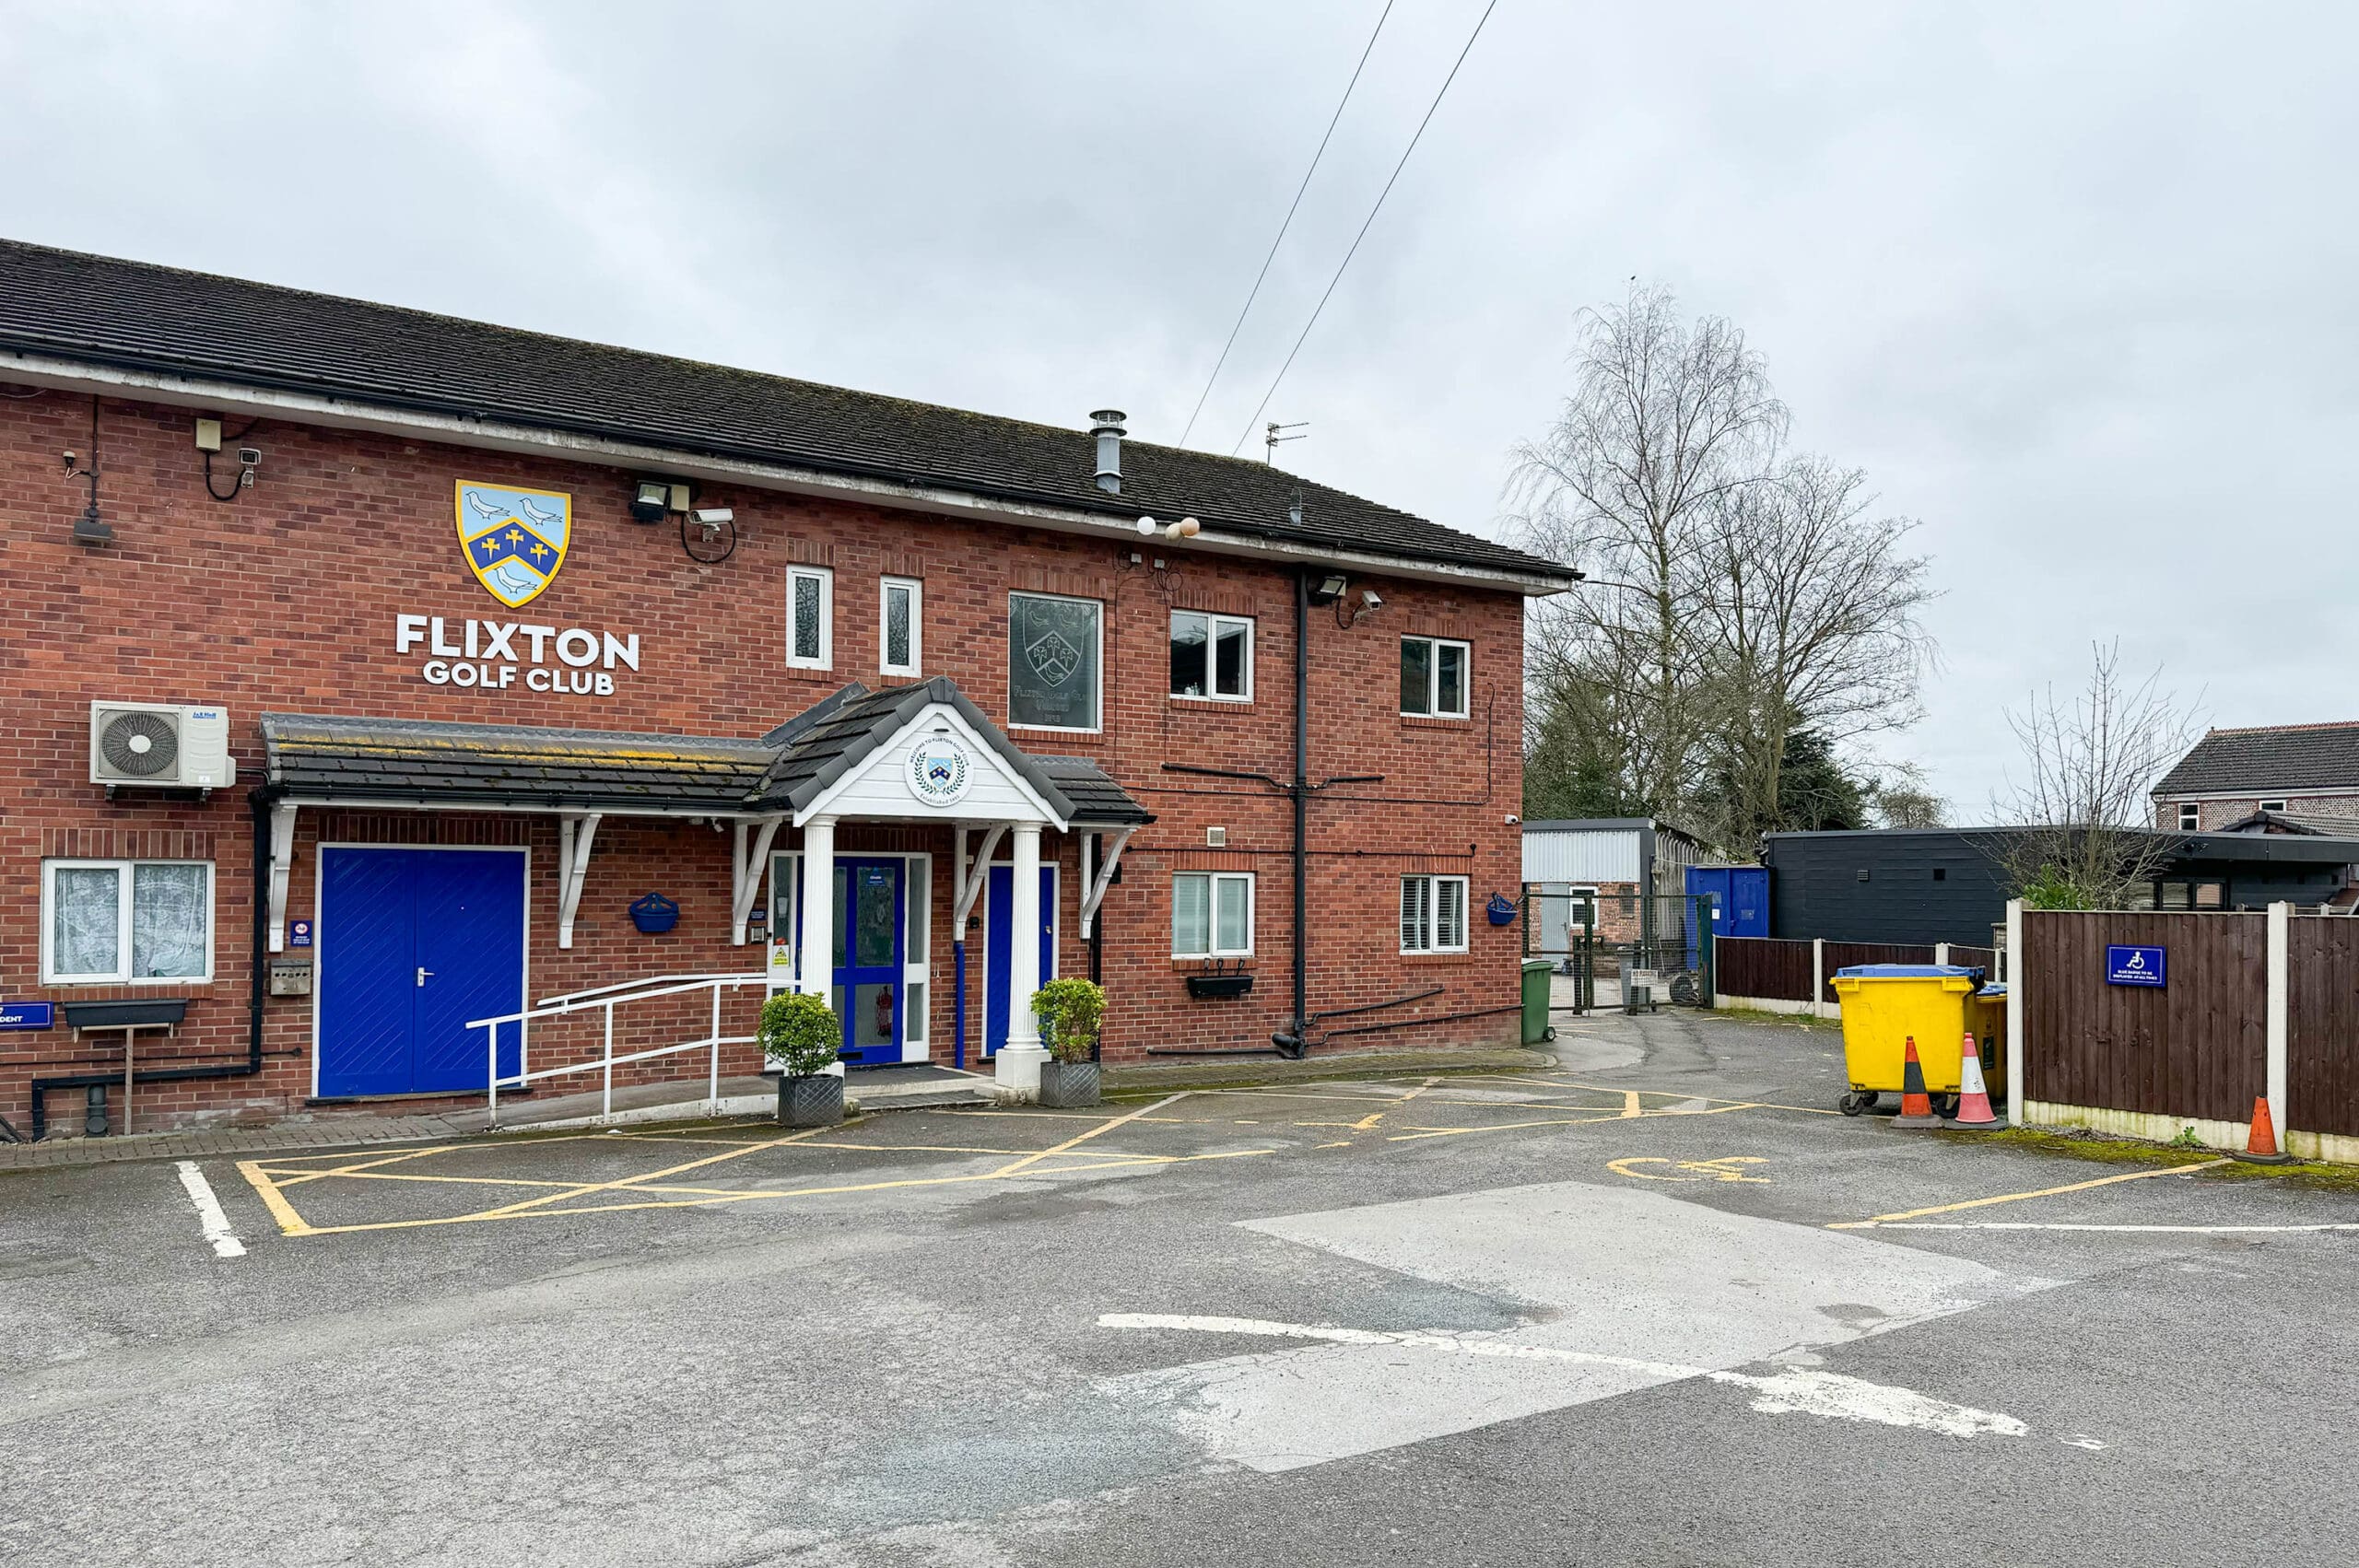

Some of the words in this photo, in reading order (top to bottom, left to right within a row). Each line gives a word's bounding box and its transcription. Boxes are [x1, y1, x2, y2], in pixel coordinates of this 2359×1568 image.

[396, 614, 640, 672] FLIXTON
[422, 660, 518, 690] GOLF
[525, 668, 616, 696] CLUB
[910, 742, 925, 763] WELCOME
[953, 743, 964, 753] GOLF
